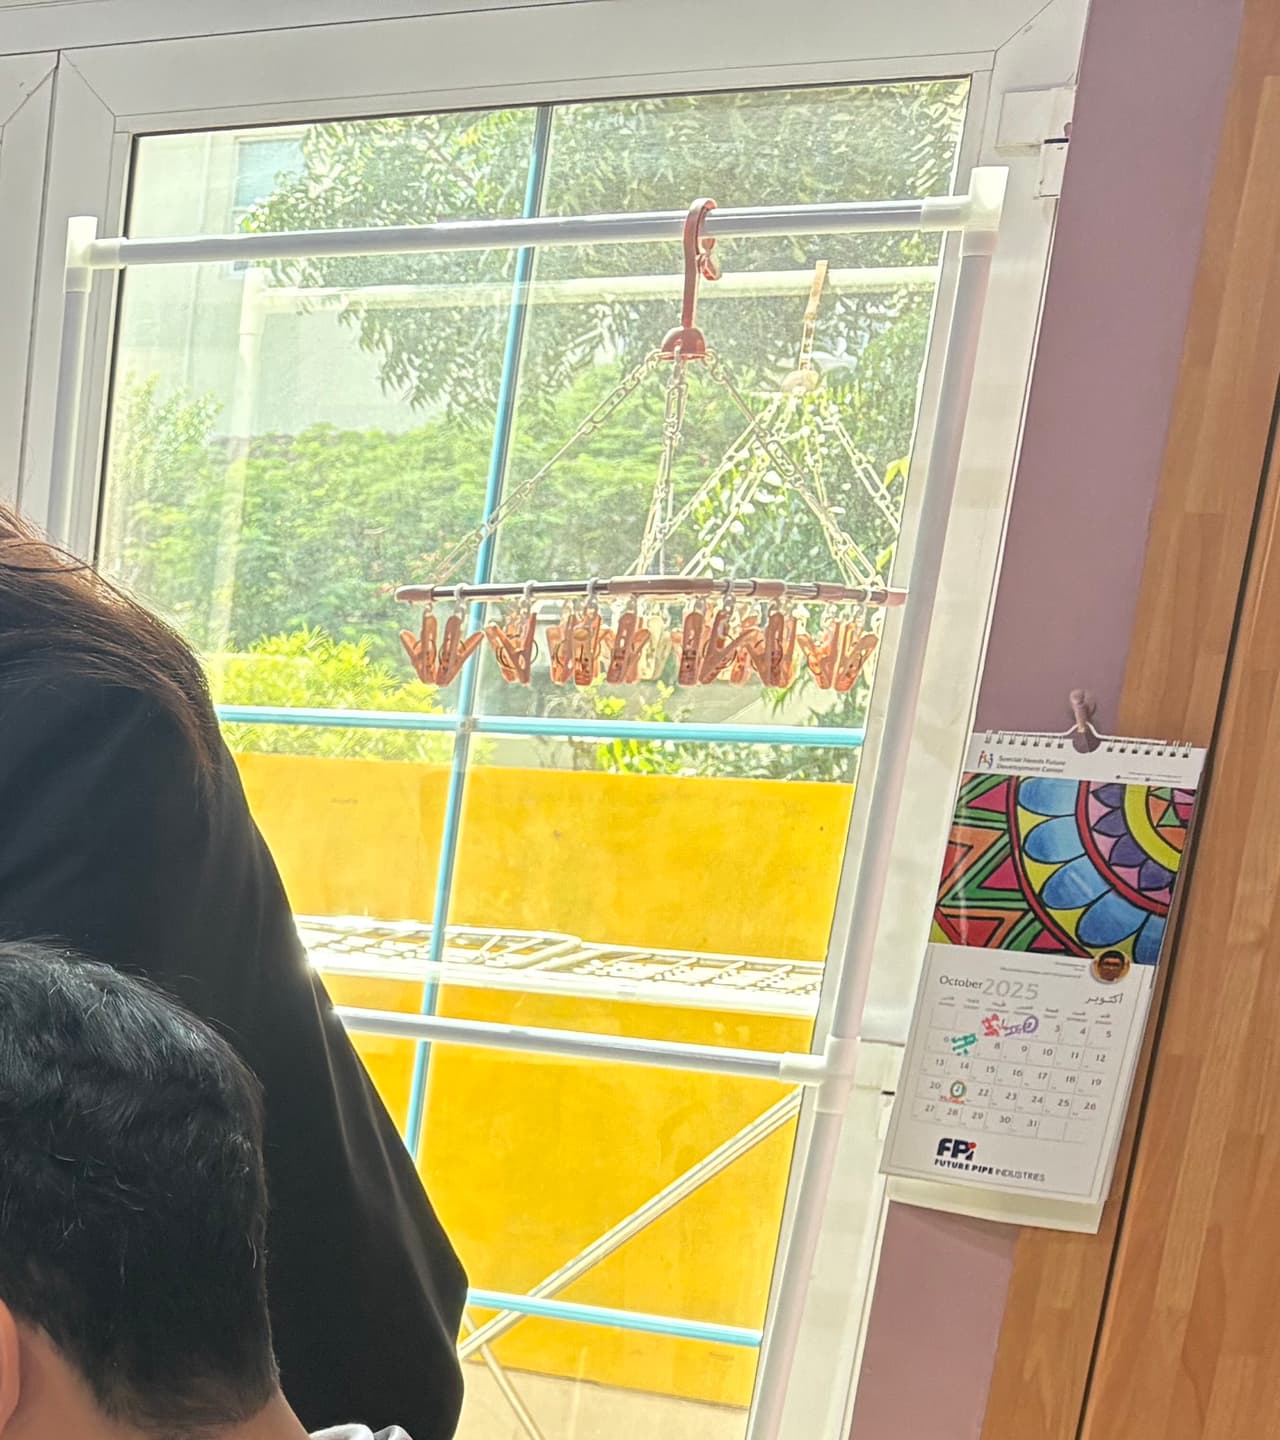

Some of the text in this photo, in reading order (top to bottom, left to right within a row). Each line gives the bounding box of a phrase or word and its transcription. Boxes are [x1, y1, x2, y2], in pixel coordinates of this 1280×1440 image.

[939, 975, 1039, 1001] October 2025
[1106, 1030, 1112, 1038] 5
[1043, 1048, 1053, 1056] 10
[1096, 1054, 1106, 1062] 12
[1038, 1072, 1048, 1080] 17
[1066, 1075, 1075, 1083] 18
[1058, 1099, 1069, 1107] 25
[925, 1104, 935, 1112] 27
[999, 1115, 1011, 1124] 30
[934, 1158, 1046, 1181] FUTURE PIPE INDUSTRIES
